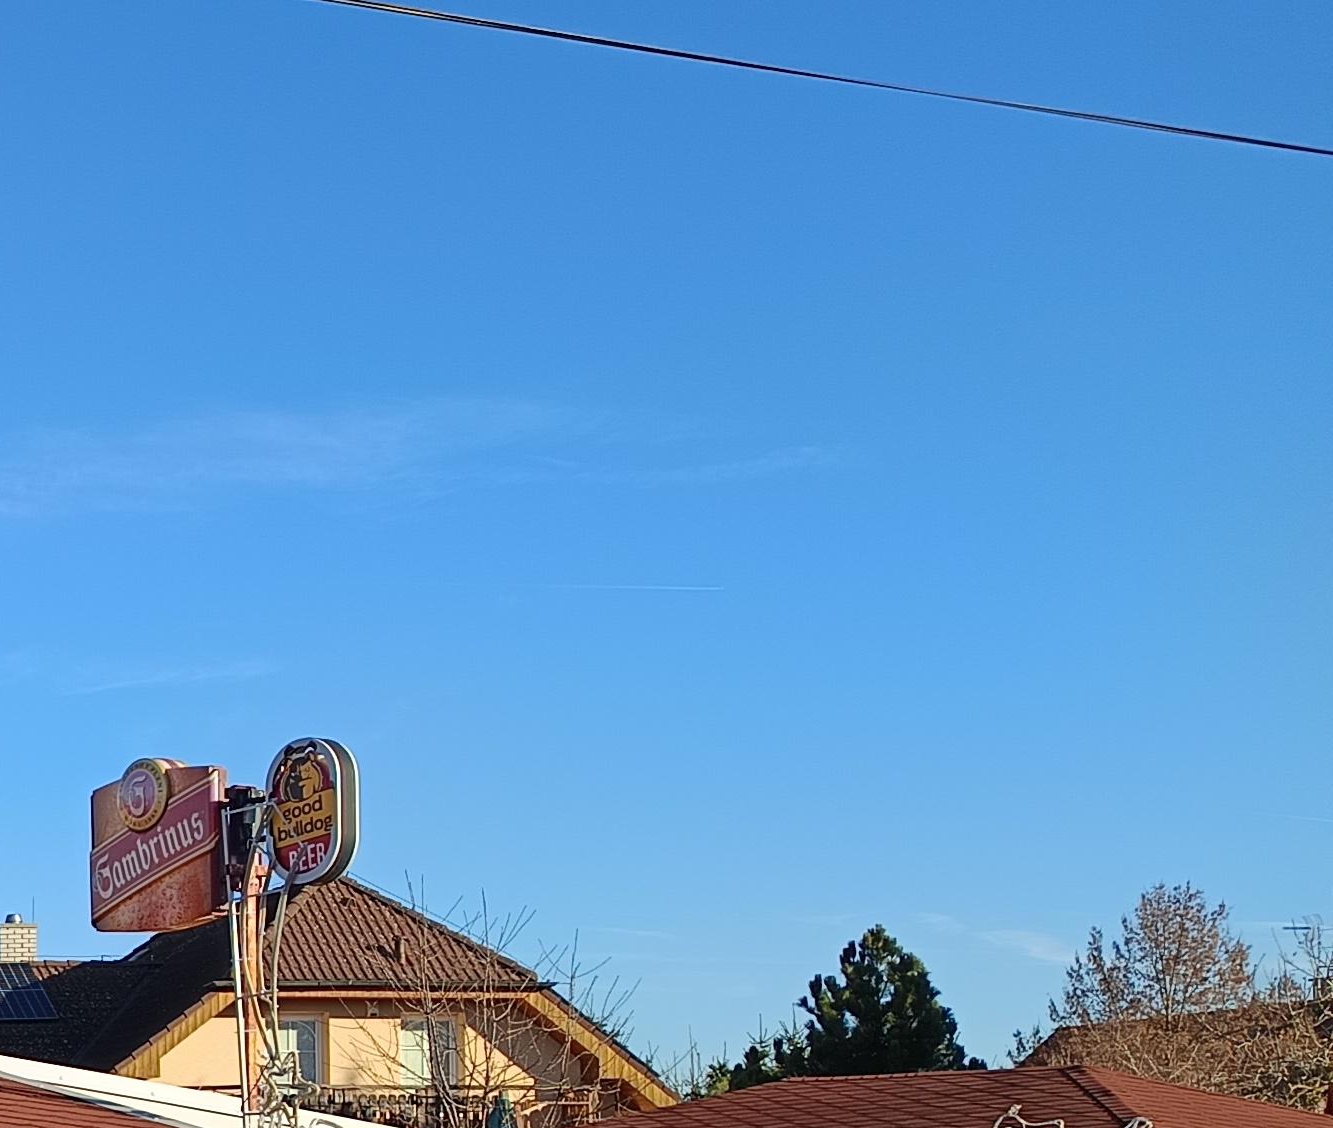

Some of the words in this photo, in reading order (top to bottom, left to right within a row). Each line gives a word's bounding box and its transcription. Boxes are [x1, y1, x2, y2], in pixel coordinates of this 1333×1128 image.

[282, 794, 323, 825] good
[277, 814, 333, 842] bulldog
[95, 812, 204, 899] Gambrinus
